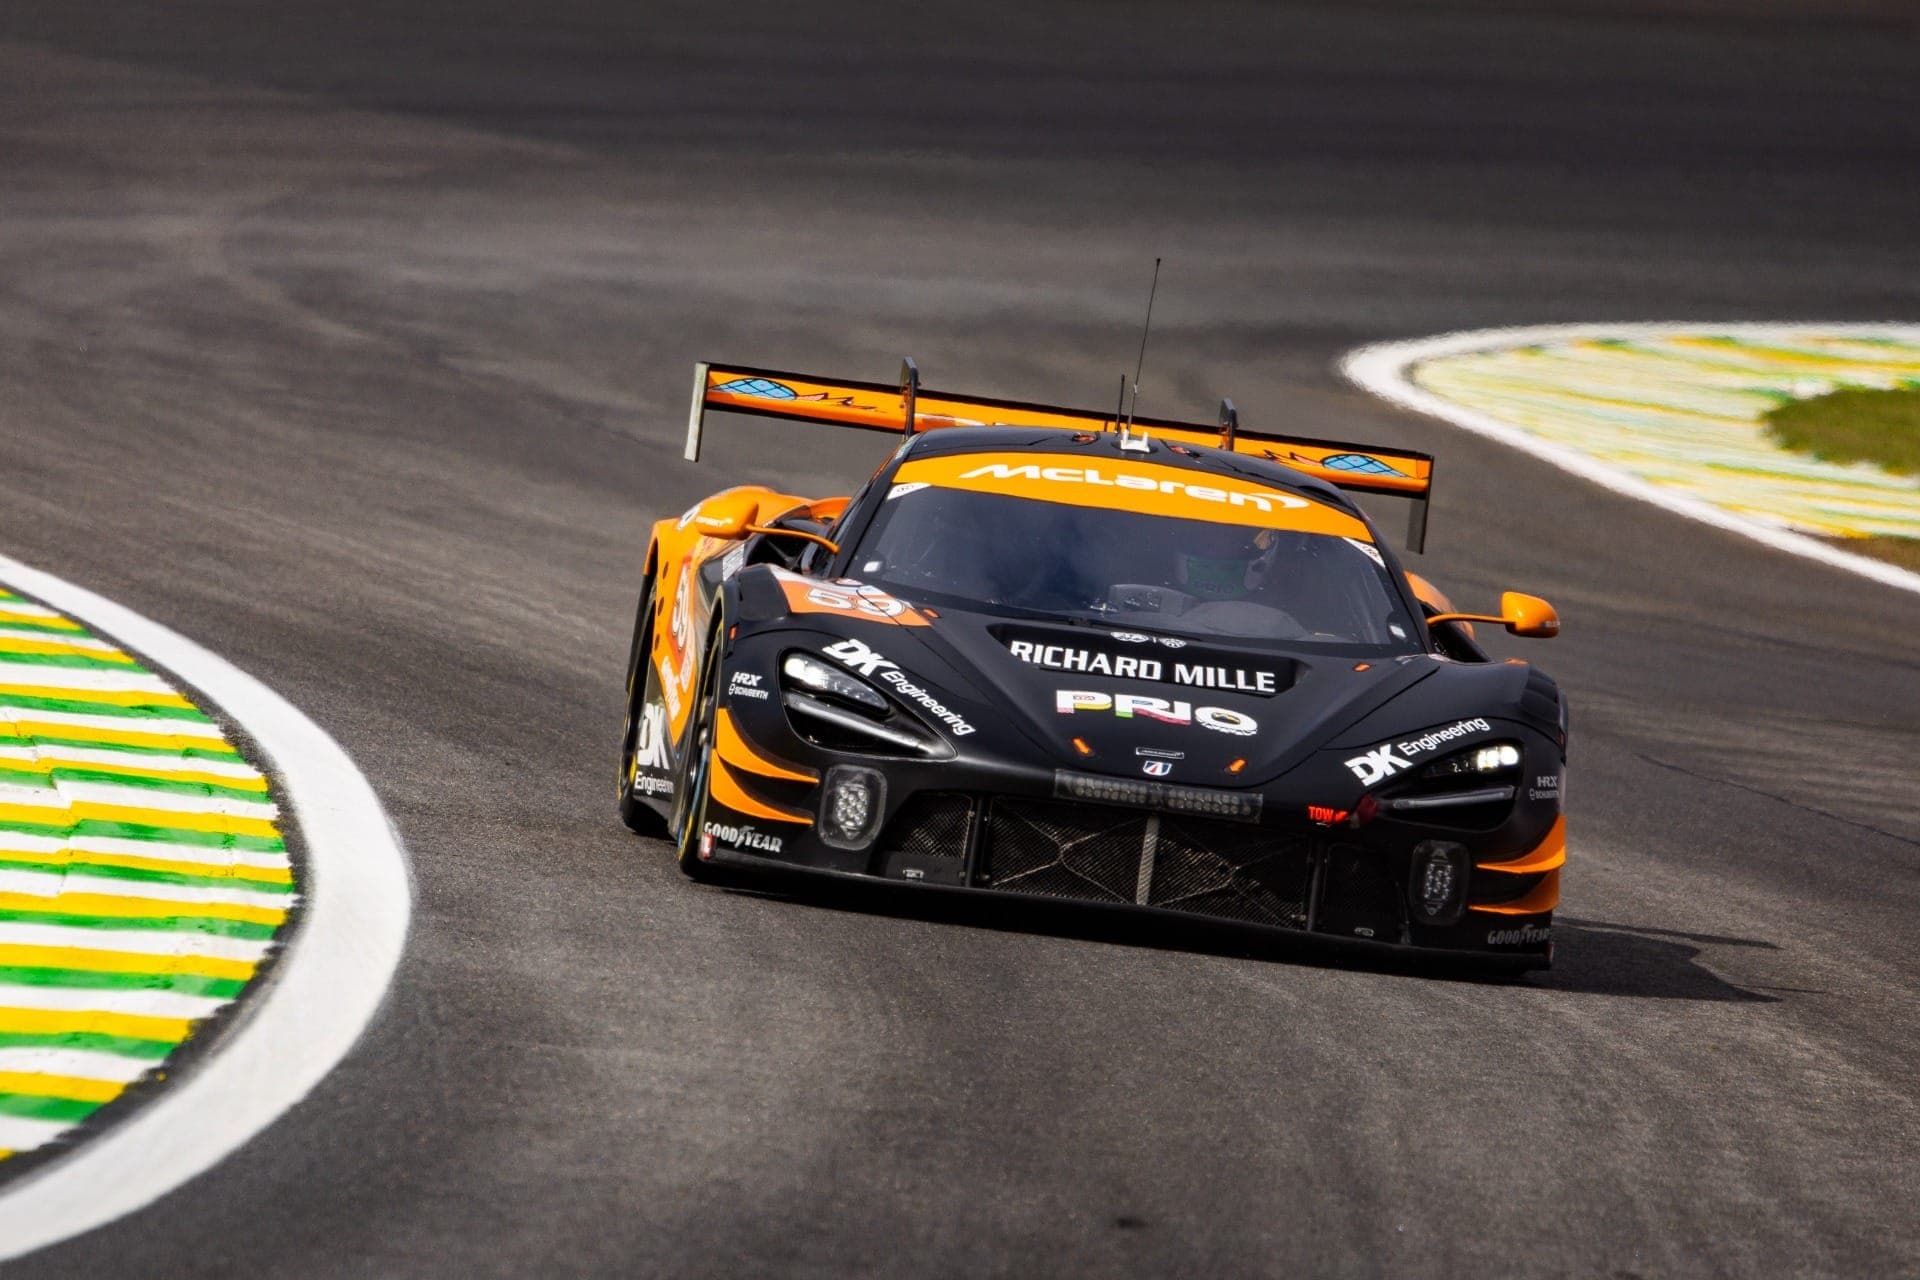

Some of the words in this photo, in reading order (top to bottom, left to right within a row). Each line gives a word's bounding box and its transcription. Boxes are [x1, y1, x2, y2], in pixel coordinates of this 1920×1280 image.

[960, 464, 1273, 512] McLaren
[808, 587, 905, 617] 59
[731, 672, 763, 687] HRX
[822, 638, 900, 677] DK
[881, 670, 976, 736] Engineering
[1010, 640, 1162, 681] RICHARD
[1173, 663, 1276, 693] MILLE
[636, 702, 670, 770] DK
[1056, 690, 1258, 736] PRIO
[1344, 744, 1413, 787] DK
[1397, 716, 1490, 757] Engineering
[704, 822, 783, 852] GOODYEAR
[1308, 806, 1334, 821] TOW
